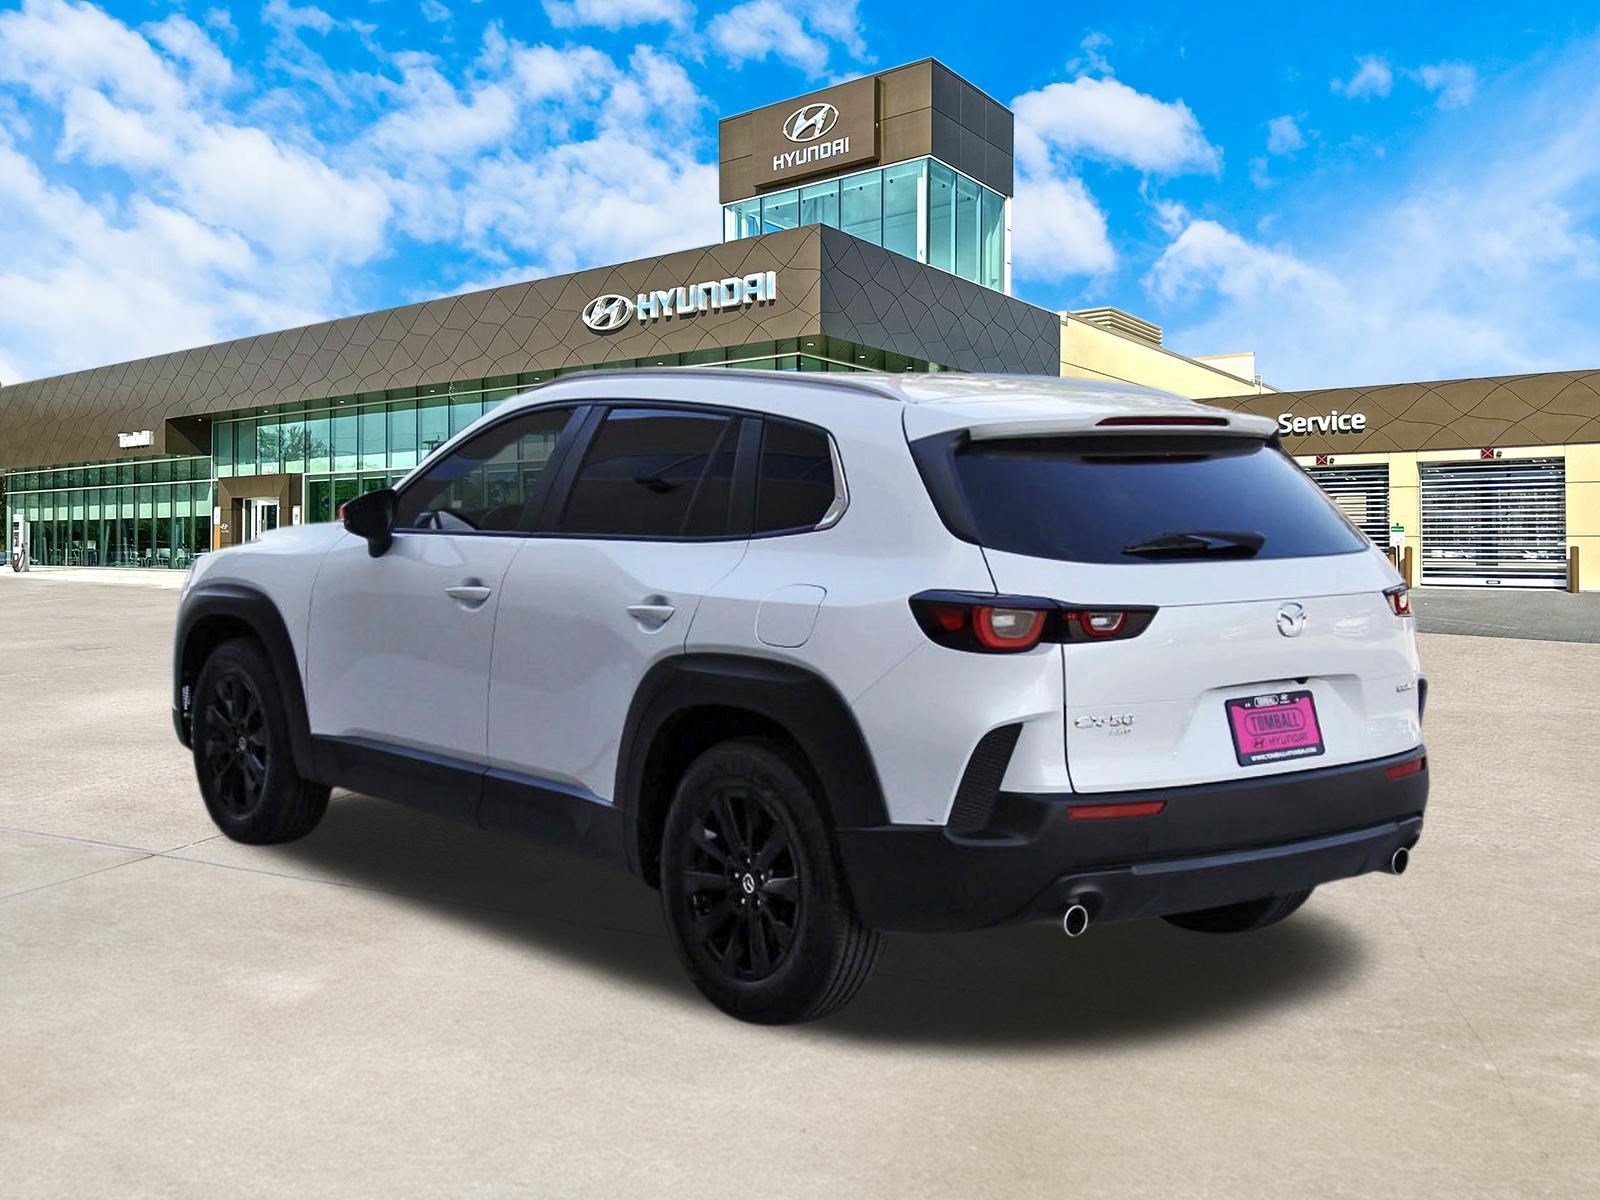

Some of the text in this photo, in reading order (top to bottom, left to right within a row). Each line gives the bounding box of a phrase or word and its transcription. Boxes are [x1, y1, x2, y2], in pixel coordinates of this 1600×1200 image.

[773, 136, 850, 171] HYUNDAI
[636, 270, 778, 321] HYUNDAI
[1278, 410, 1367, 434] Service
